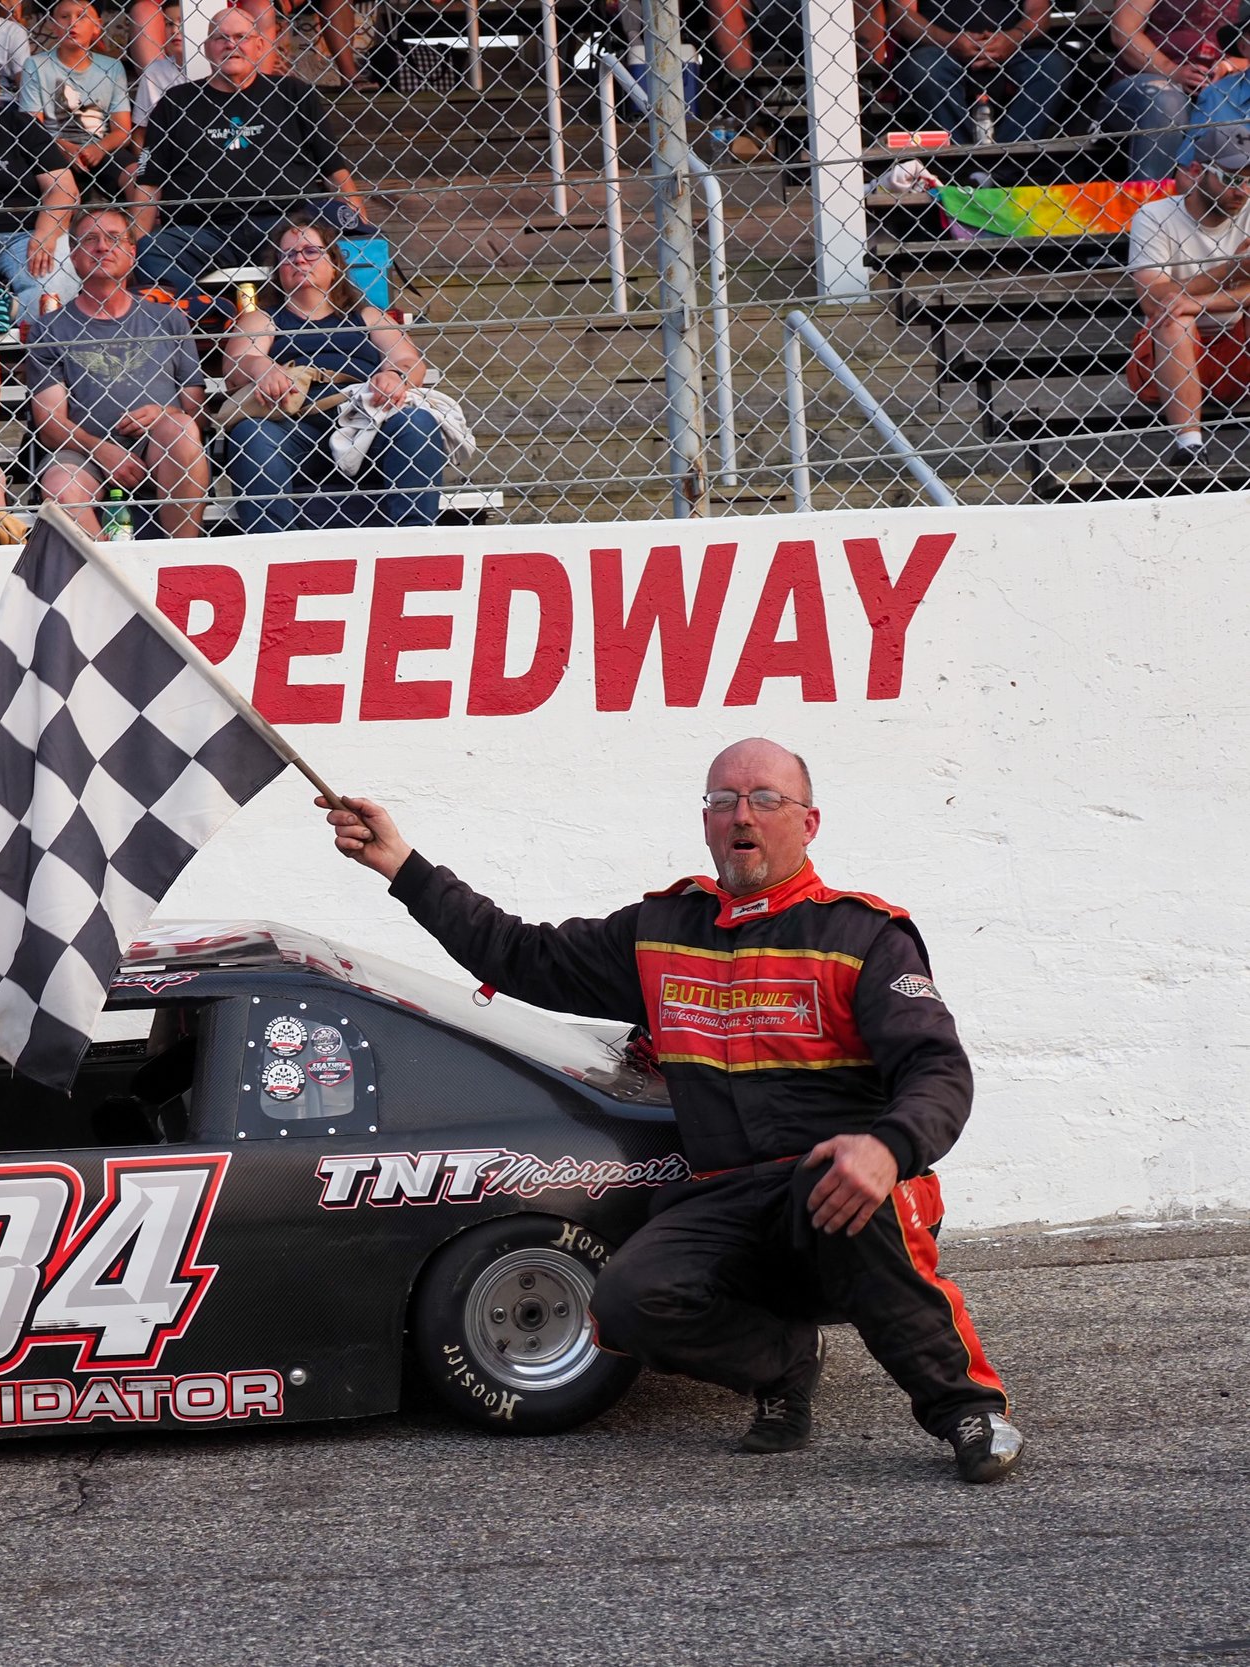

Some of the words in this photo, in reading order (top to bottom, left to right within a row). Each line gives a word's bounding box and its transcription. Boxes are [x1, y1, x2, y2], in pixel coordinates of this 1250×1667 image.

[157, 533, 956, 725] PEEDWAY
[663, 983, 747, 1010] BUTLER
[750, 992, 793, 1008] BUILT
[264, 1016, 288, 1039] FEATURE
[289, 1016, 308, 1041] WINNER
[662, 1008, 719, 1027] Professional
[743, 1014, 786, 1030] Systems
[261, 1059, 284, 1083] FEATURE
[286, 1059, 305, 1083] WINNER
[320, 1150, 501, 1206] TNT
[477, 1153, 684, 1197] Motorsports
[443, 1344, 525, 1420] Hoosier
